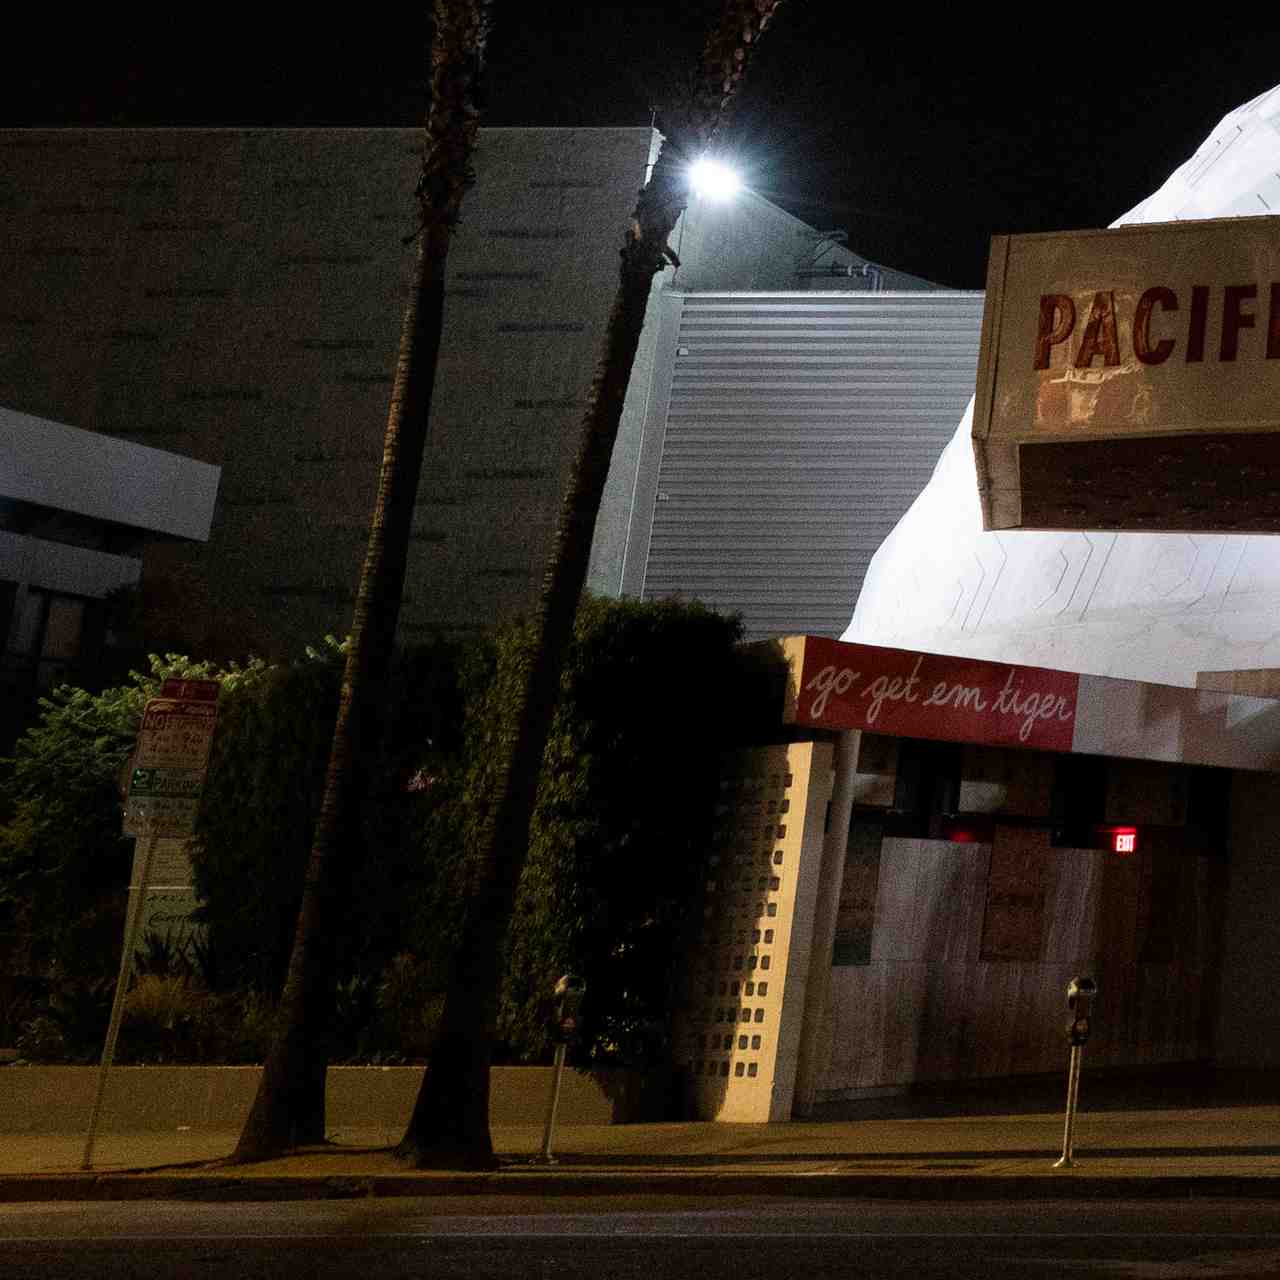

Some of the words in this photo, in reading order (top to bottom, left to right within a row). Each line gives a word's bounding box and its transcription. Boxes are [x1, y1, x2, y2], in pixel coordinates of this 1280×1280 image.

[805, 665, 860, 719] go
[861, 655, 924, 724] get
[922, 680, 987, 713] em
[991, 669, 1073, 741] tiger
